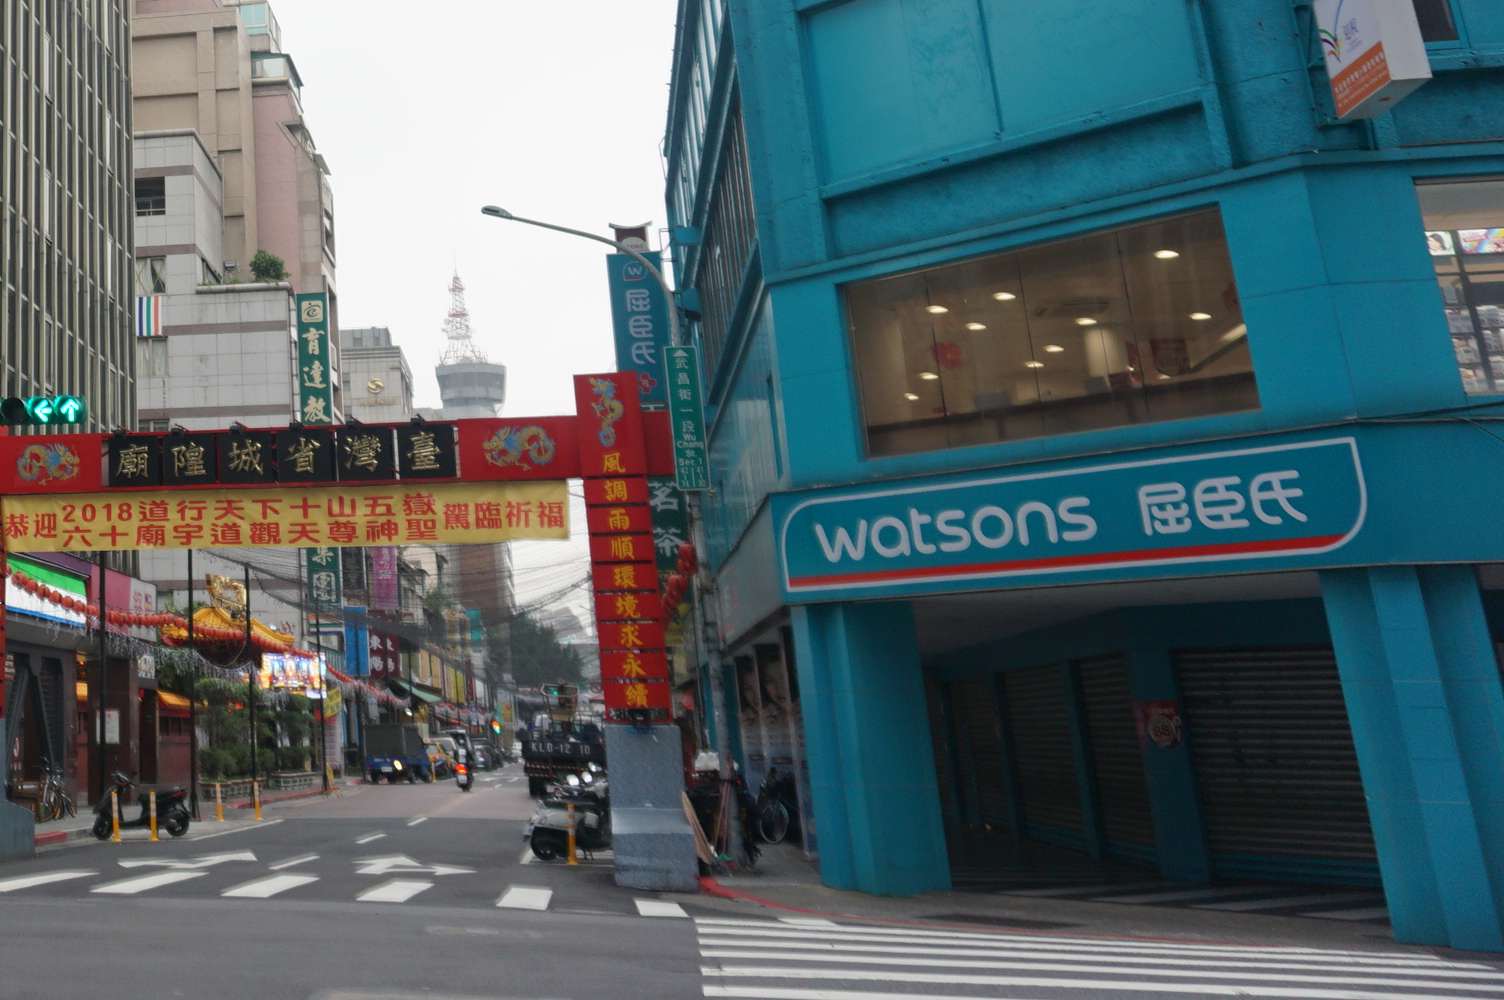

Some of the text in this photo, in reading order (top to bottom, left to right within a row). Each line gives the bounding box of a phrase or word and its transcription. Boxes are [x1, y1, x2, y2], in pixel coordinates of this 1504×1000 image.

[625, 288, 657, 365] 屈臣氏
[301, 327, 332, 422] 育達教
[675, 357, 695, 433] 武昌街一段
[677, 440, 704, 450] Chang
[682, 433, 696, 441] Wu
[5, 512, 58, 540] 恭迎
[443, 500, 565, 531] 駕臨祈福
[62, 518, 439, 548] 六十廟宇道觀天尊神聖
[648, 481, 686, 557] 茗茶
[815, 496, 1097, 563] watsons
[1138, 470, 1308, 537] 屈臣氏
[603, 452, 649, 708] 風調雨順環境求永續
